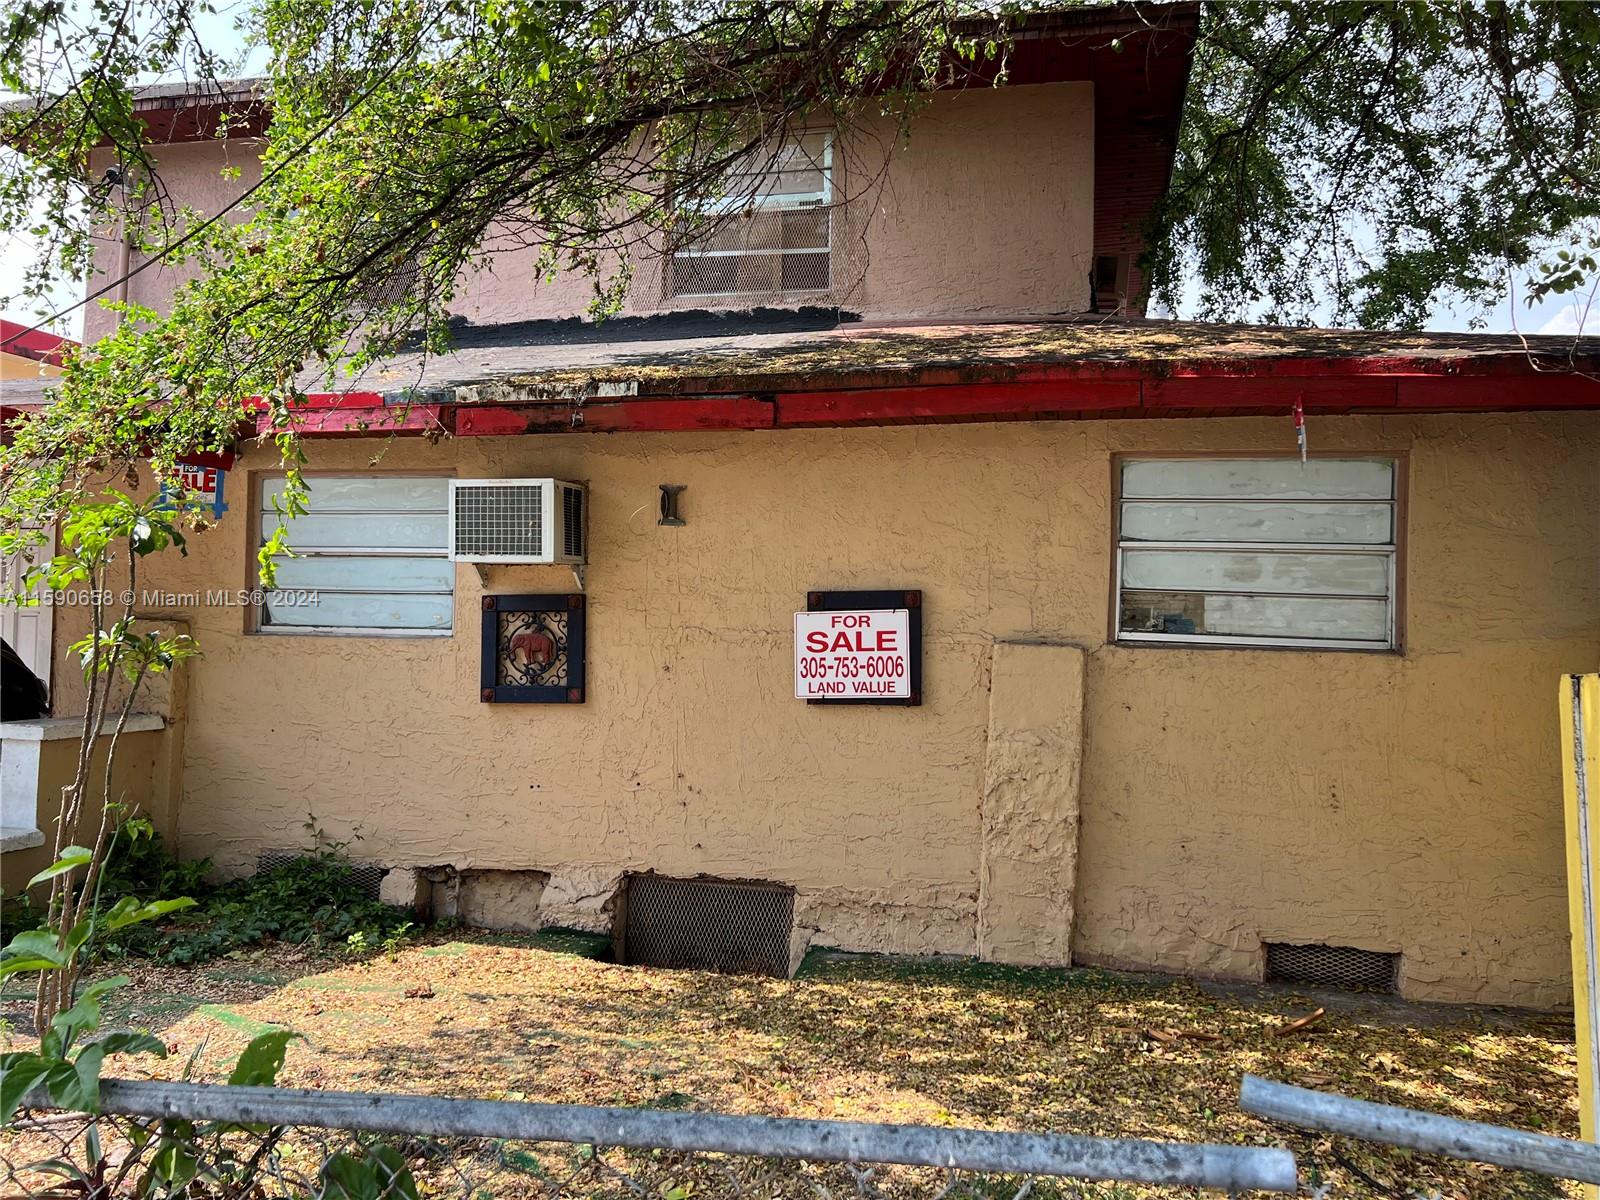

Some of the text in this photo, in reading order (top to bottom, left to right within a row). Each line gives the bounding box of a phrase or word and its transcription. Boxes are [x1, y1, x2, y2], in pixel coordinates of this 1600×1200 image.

[831, 615, 871, 628] FOR
[806, 630, 898, 653] SALE
[800, 655, 904, 679] 305-753-6006
[808, 681, 896, 694] LAND VALUE
